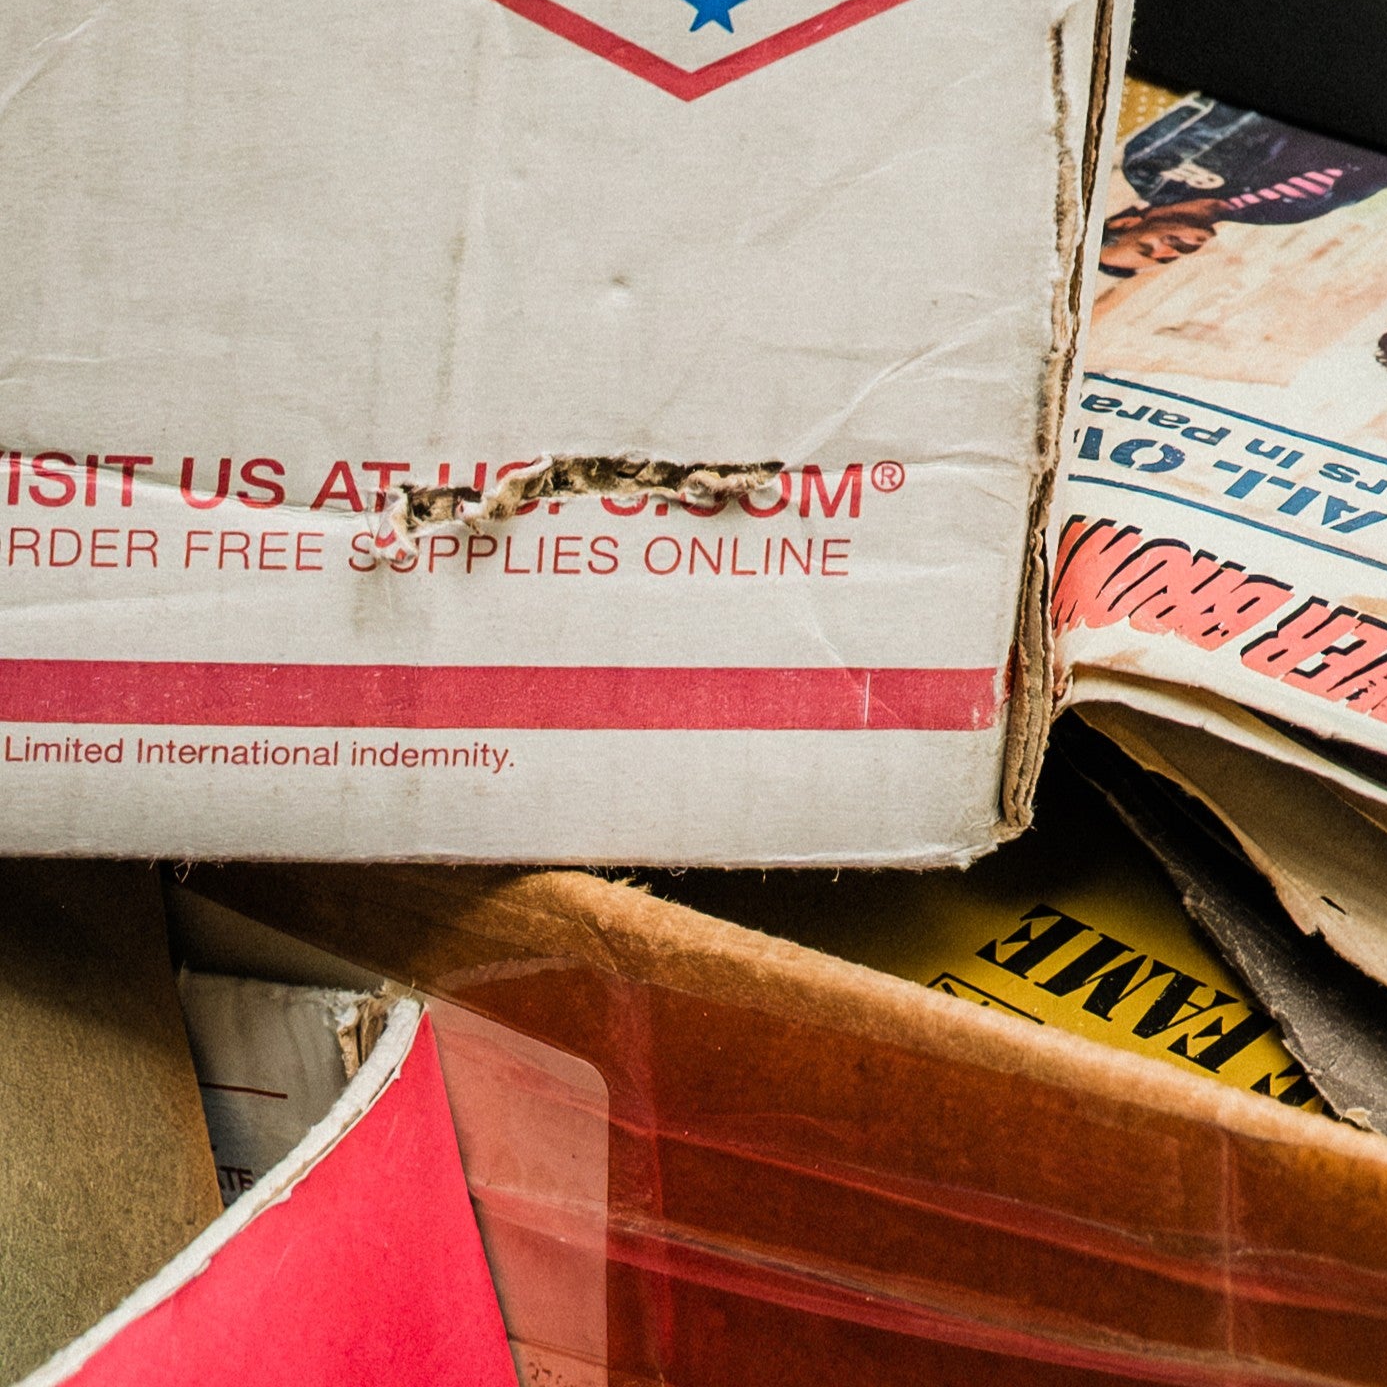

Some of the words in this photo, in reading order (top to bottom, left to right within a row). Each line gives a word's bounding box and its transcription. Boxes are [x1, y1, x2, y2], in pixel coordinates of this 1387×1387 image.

[1079, 392, 1231, 446] Para
[179, 456, 286, 510] US
[0, 526, 159, 569] RDER
[184, 530, 325, 571] FREE
[643, 535, 852, 576] ONLINE
[4, 734, 124, 765] Limited
[137, 737, 339, 767] International
[350, 740, 516, 774] indemnity.
[975, 903, 1274, 1076] FAME
